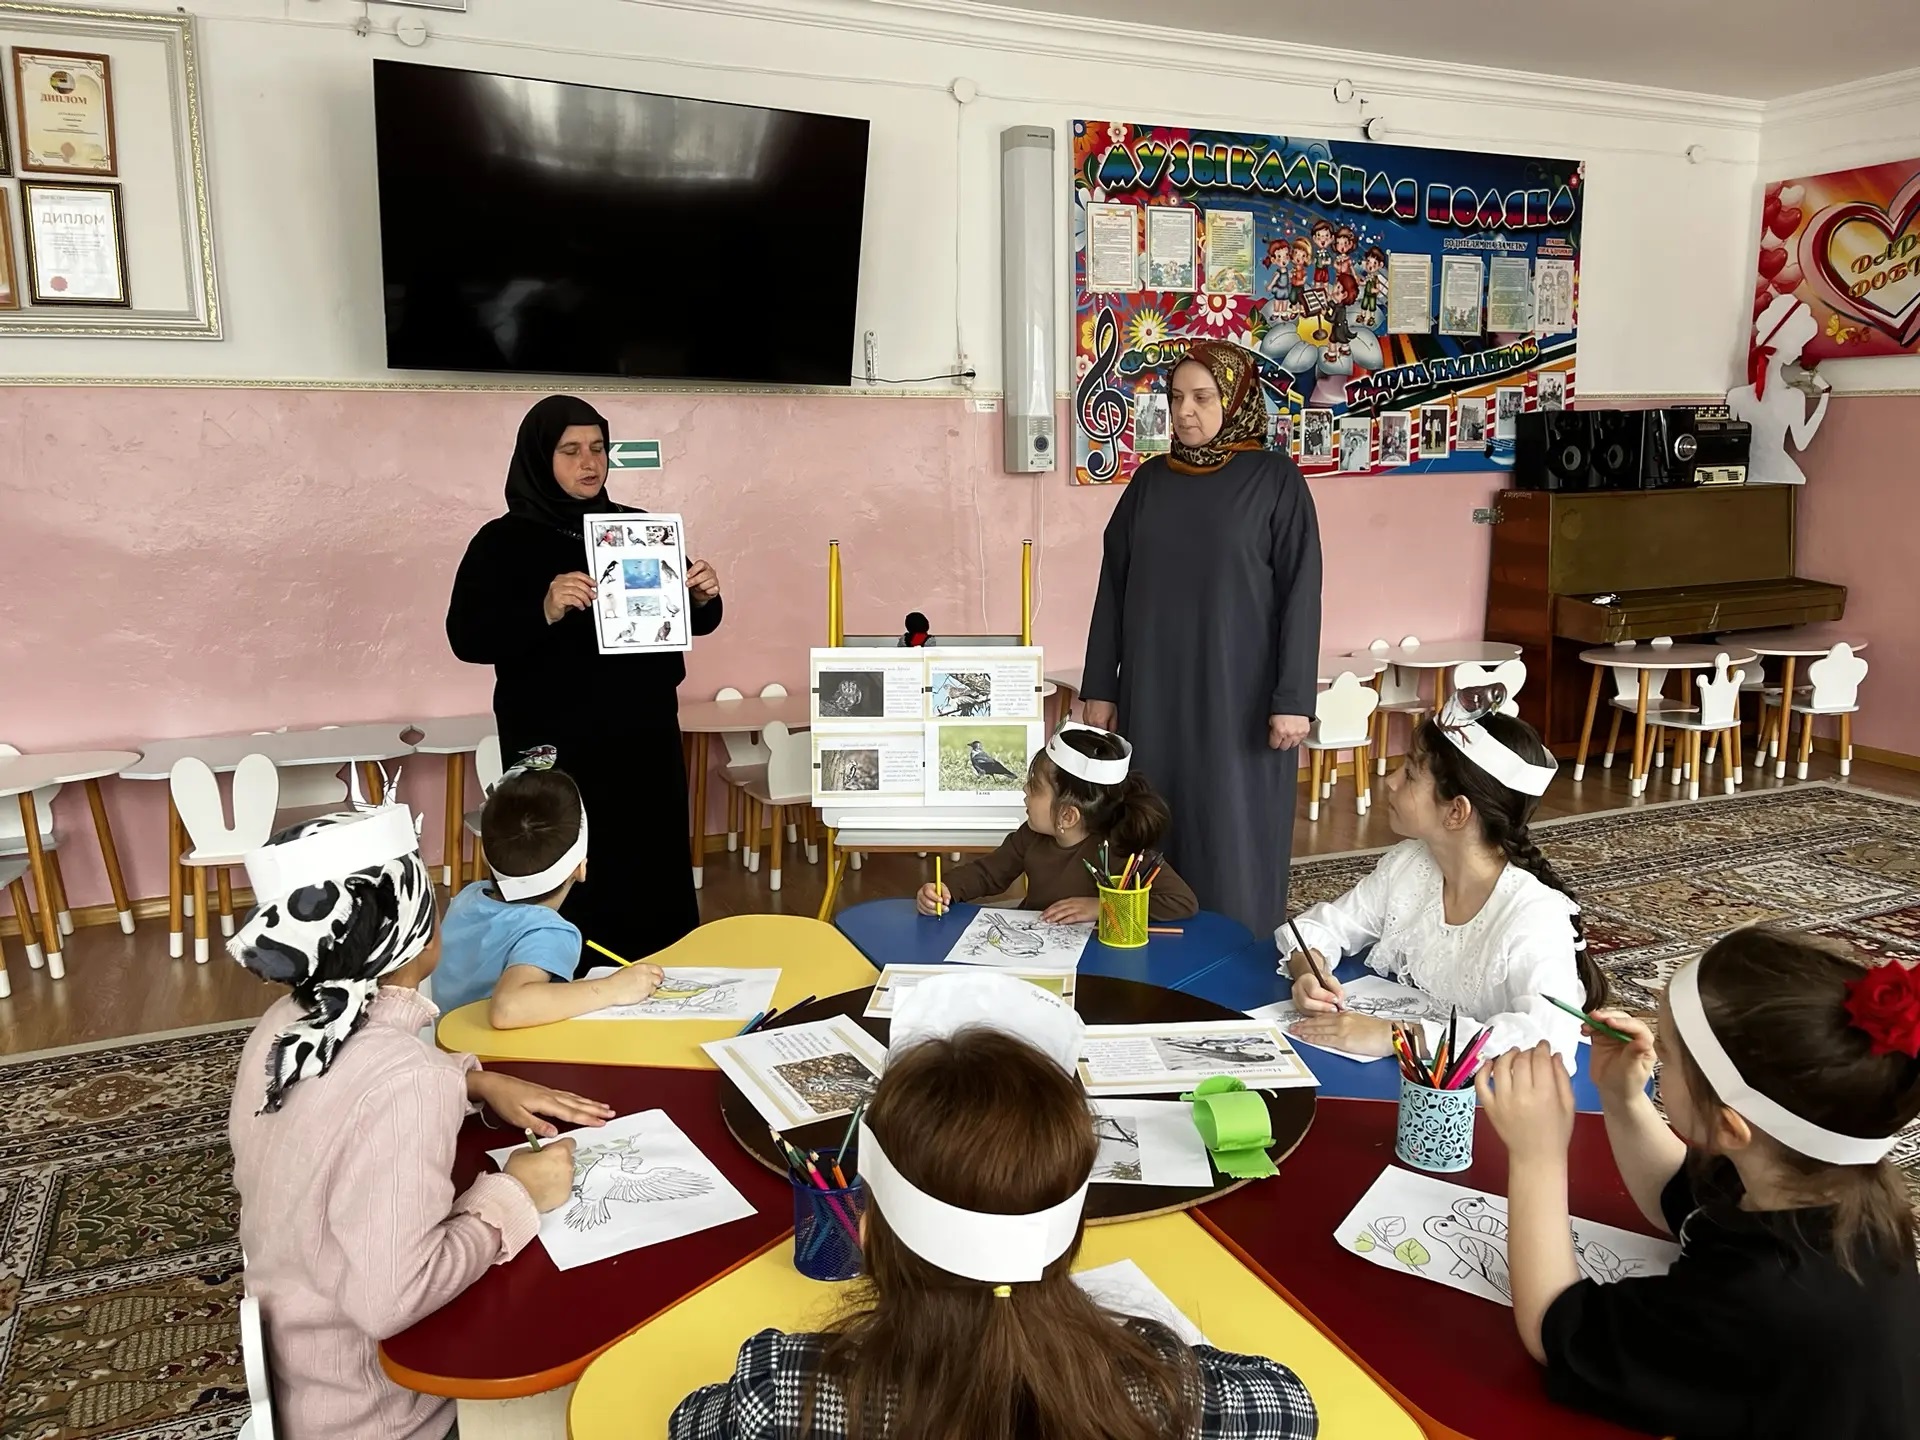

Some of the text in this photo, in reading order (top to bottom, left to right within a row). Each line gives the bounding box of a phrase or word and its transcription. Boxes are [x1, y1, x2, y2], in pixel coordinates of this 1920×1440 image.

[40, 92, 87, 105] ДИПЛОМ
[1099, 140, 1576, 229] МУЗЫКАЛЬНАЯ ПОЛЯНА
[42, 212, 105, 225] ДИПЛОМ
[1344, 337, 1539, 407] РАДУГА ТАЛАНТОВ
